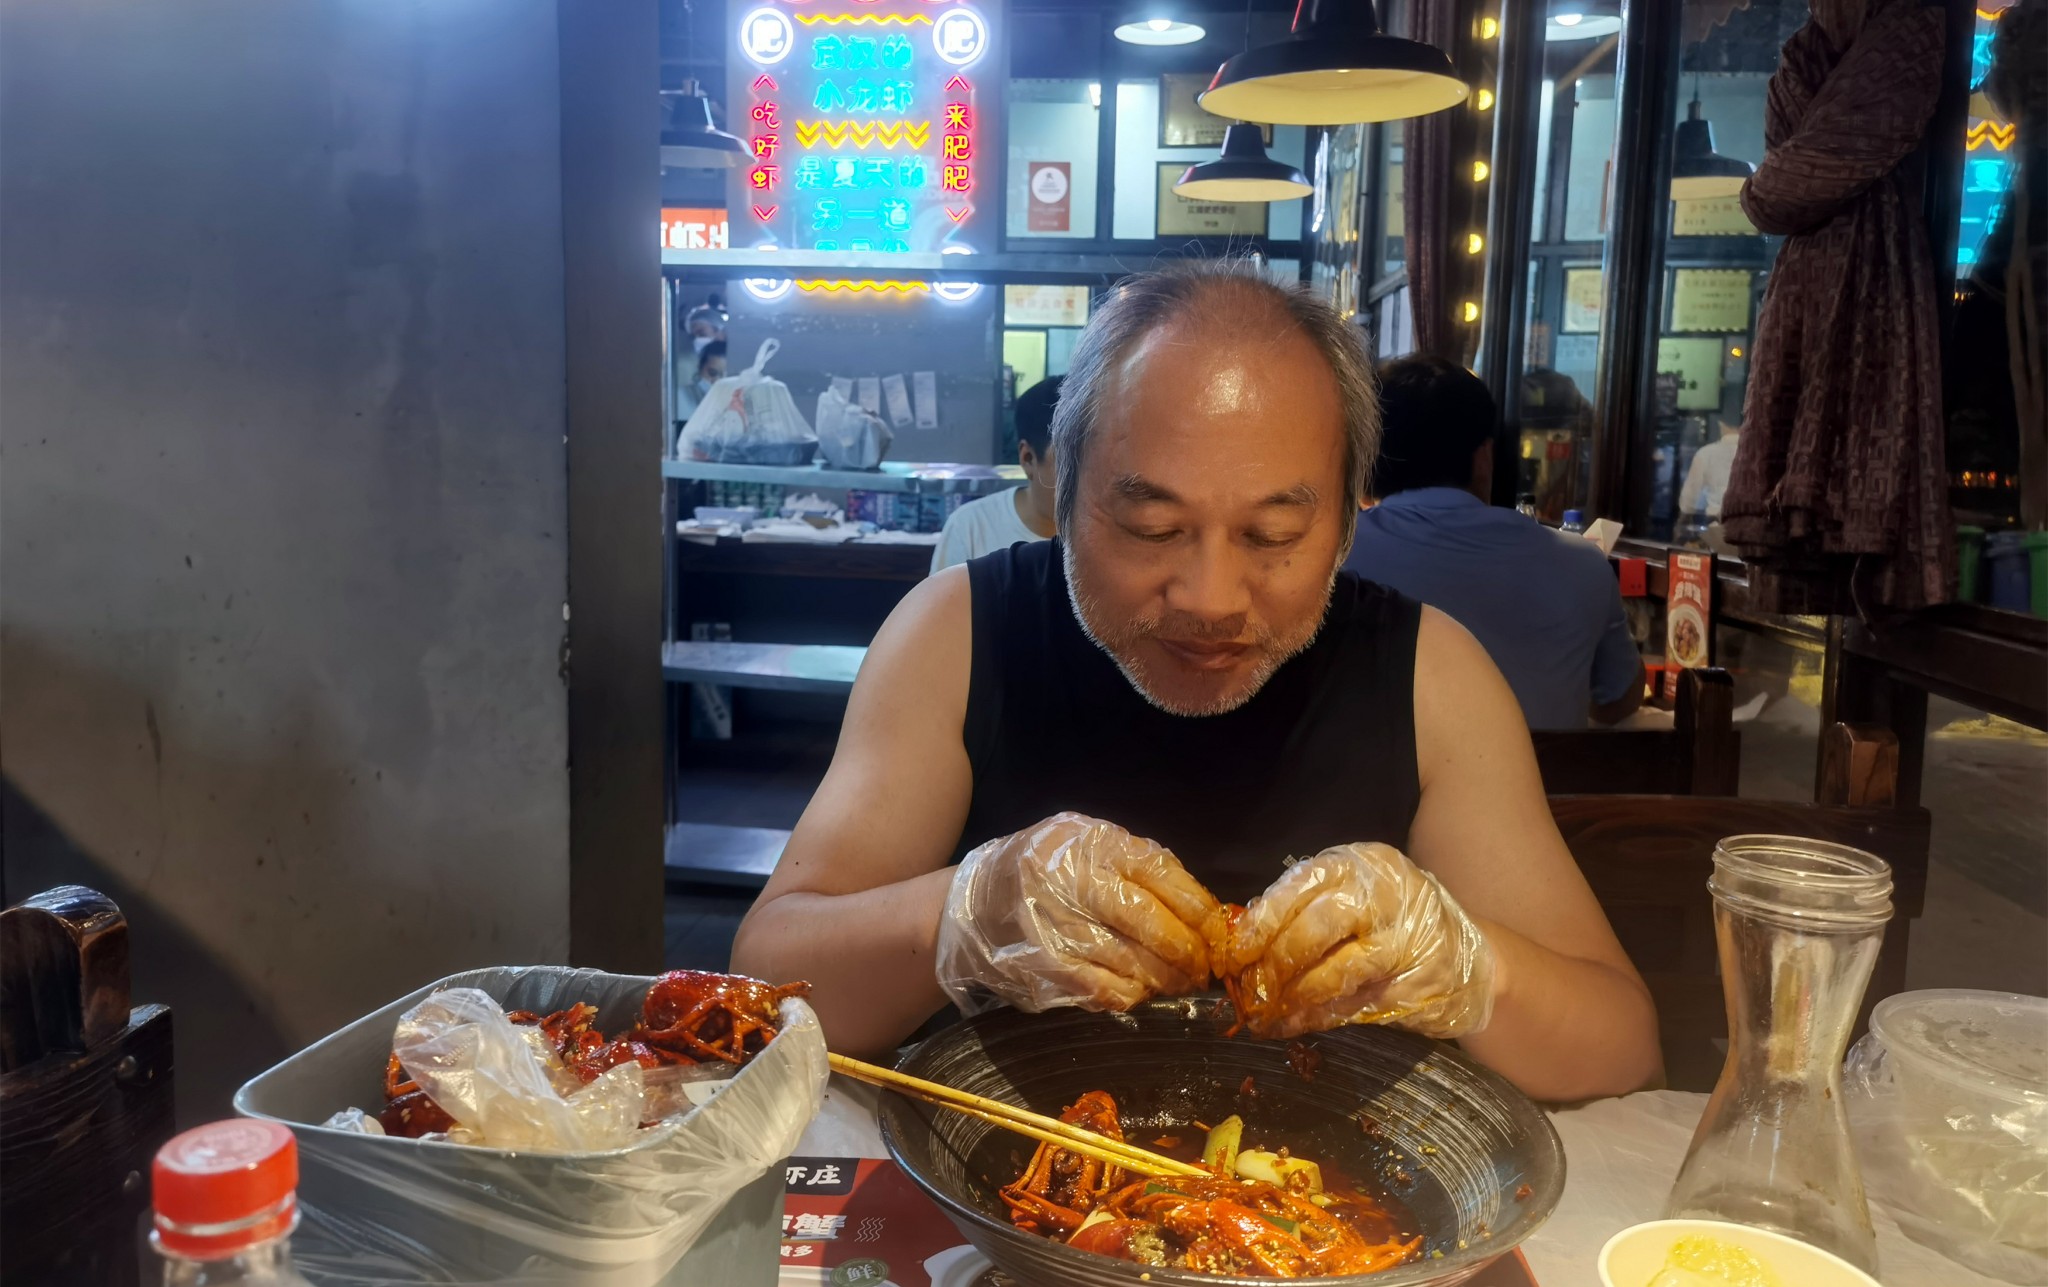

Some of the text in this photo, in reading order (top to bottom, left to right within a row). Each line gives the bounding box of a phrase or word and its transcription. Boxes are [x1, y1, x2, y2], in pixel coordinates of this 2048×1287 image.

[751, 18, 784, 53] 肥
[812, 34, 913, 71] 武汉的
[943, 18, 975, 53] 肥
[812, 79, 914, 114] 小龙虾
[752, 101, 782, 191] 吃好虾
[942, 103, 970, 192] 来肥肥
[795, 155, 928, 190] 是夏天的
[812, 197, 913, 232] 另一道
[786, 1165, 841, 1185] 虾庄
